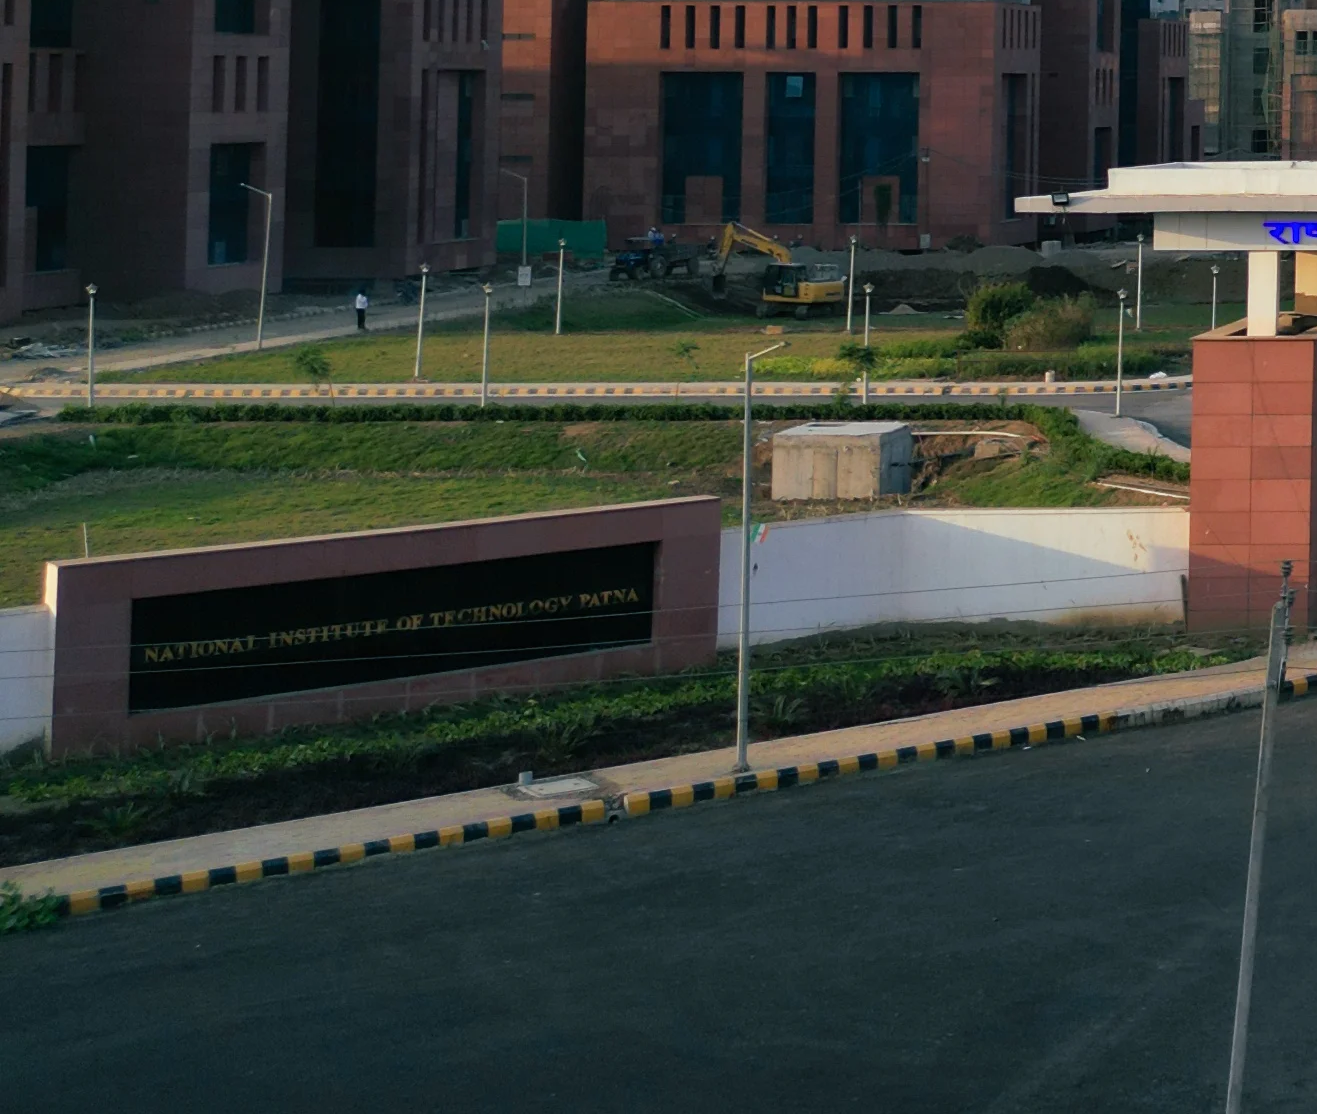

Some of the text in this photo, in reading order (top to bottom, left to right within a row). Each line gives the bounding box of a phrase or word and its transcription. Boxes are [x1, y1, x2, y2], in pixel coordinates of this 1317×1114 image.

[145, 587, 640, 663] NATIONAL INSTITUTE OF TECHNOLOGY PATNA
